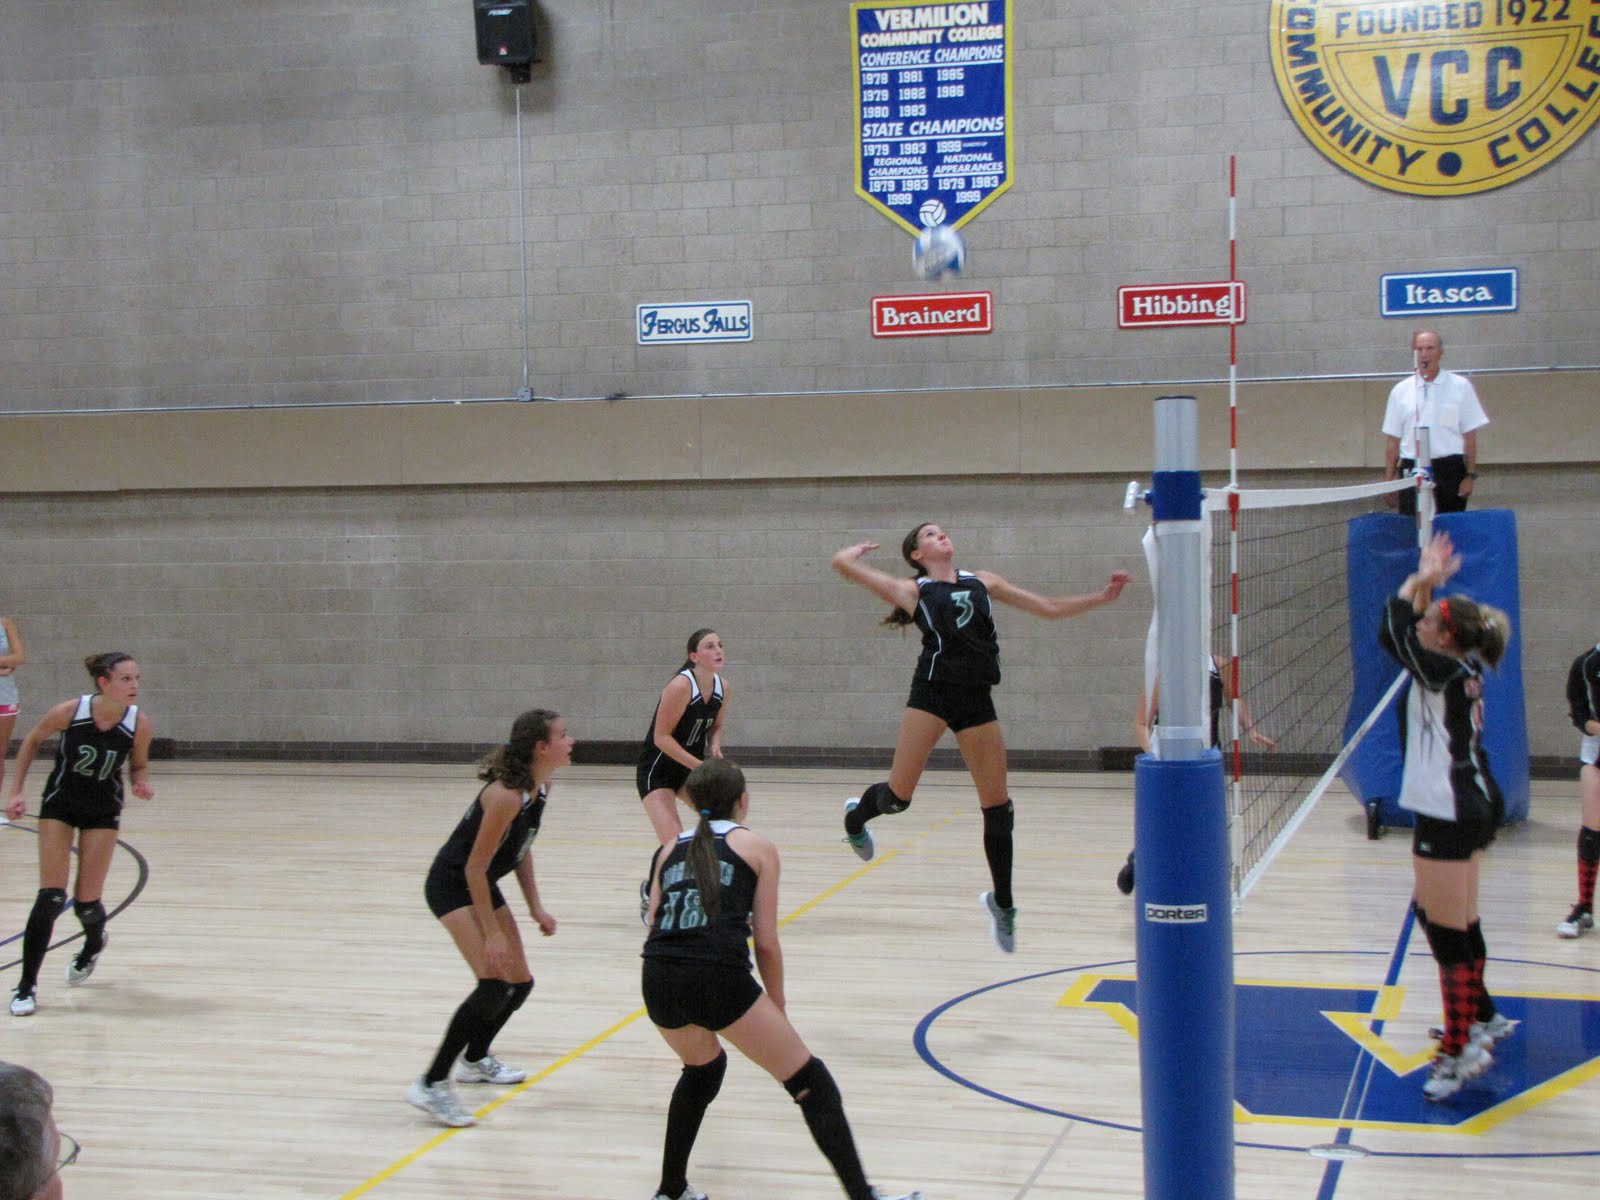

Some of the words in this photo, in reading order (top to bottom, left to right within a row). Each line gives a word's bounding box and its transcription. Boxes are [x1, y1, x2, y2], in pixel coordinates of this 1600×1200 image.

[874, 3, 989, 31] VERMILION
[1335, 2, 1482, 38] FOUNDED
[1495, 0, 1571, 26] 1922
[860, 29, 944, 48] COMMUNITY
[948, 25, 1004, 43] COLLEGE
[860, 49, 931, 67] CONFERENCE
[934, 45, 1003, 63] CHAMPIONS
[862, 73, 889, 85] 1978
[898, 70, 923, 83] 1981
[1373, 45, 1523, 126] VCC
[862, 89, 890, 102] 1979
[898, 87, 926, 100] 1982
[1286, 0, 1426, 176] OMMUNITY
[1487, 0, 1600, 168] COLLE
[862, 106, 889, 119] 1980
[899, 104, 927, 117] 1983
[862, 122, 904, 137] STATE
[909, 117, 1005, 135] CHAMPIONS
[863, 144, 890, 156] 1979
[899, 142, 927, 155] 1983
[936, 140, 962, 153] 1999
[943, 153, 993, 163] NATIONAL
[869, 166, 928, 176] CHAMPIONS
[873, 157, 923, 166] REGIONAL
[933, 162, 1004, 174] APPEARANCES
[869, 180, 896, 192] 1979
[902, 179, 929, 191] 1983
[938, 177, 965, 190] 1979
[971, 176, 999, 188] 1983
[887, 193, 913, 205] 1999
[955, 190, 981, 203] 1999
[1405, 283, 1493, 305] Itasca
[881, 303, 980, 326] Brainerd
[1132, 294, 1232, 317] Hibbing
[642, 310, 701, 336] FERGUS
[703, 308, 749, 333] FALLS
[950, 590, 974, 629] 3
[73, 744, 118, 781] 21
